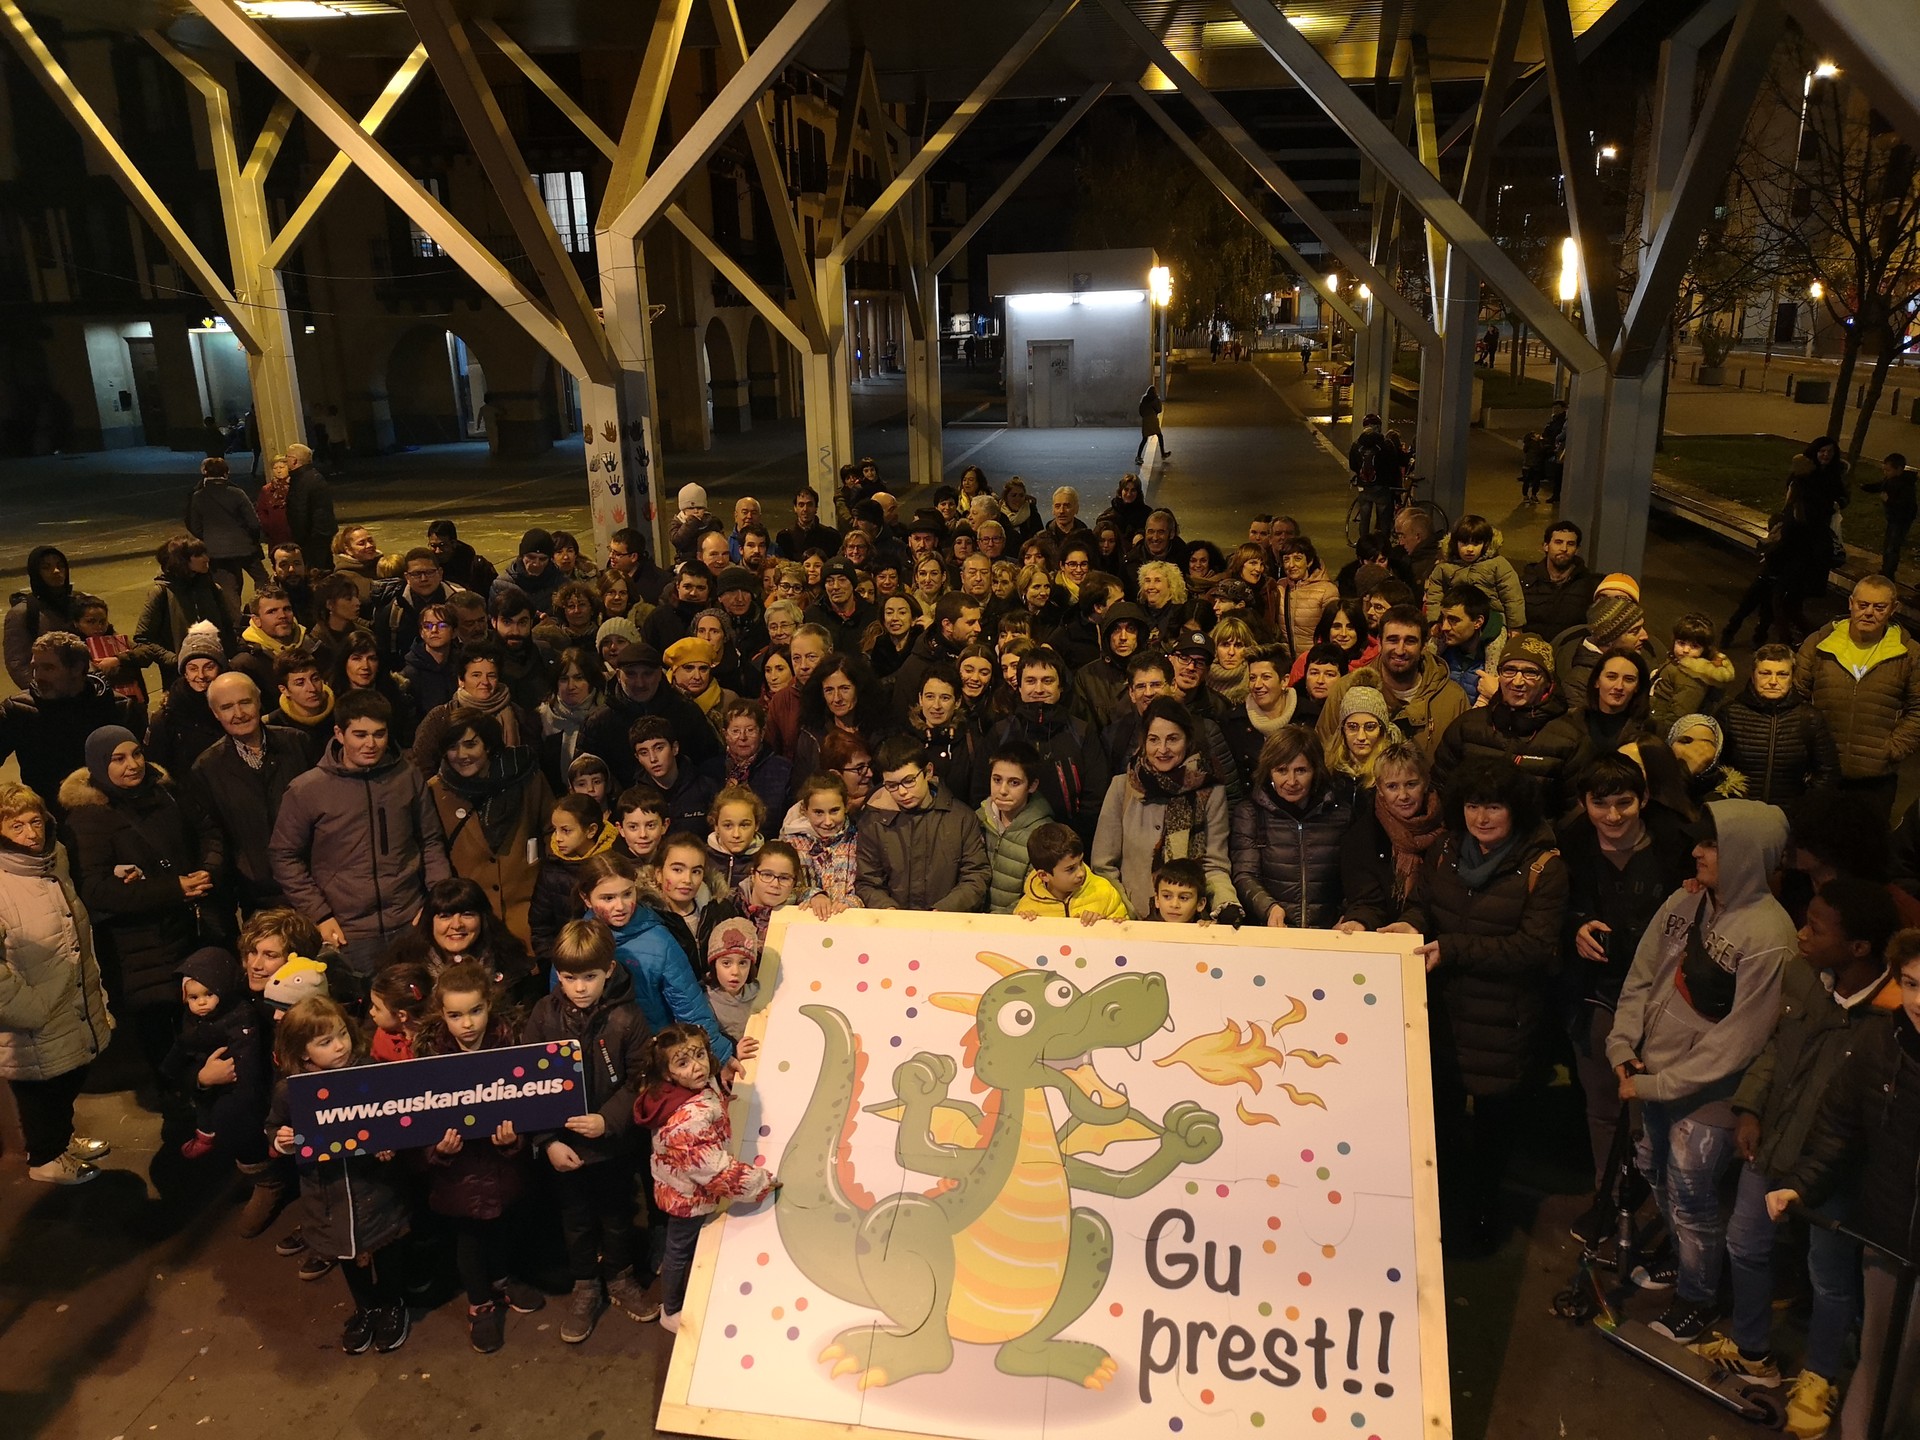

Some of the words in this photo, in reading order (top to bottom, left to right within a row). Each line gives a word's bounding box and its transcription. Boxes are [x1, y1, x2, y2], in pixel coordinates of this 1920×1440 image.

[315, 1078, 564, 1125] www.euskaraldia.eus
[1145, 1208, 1242, 1296] Gu
[1138, 1307, 1395, 1404] prest!!
